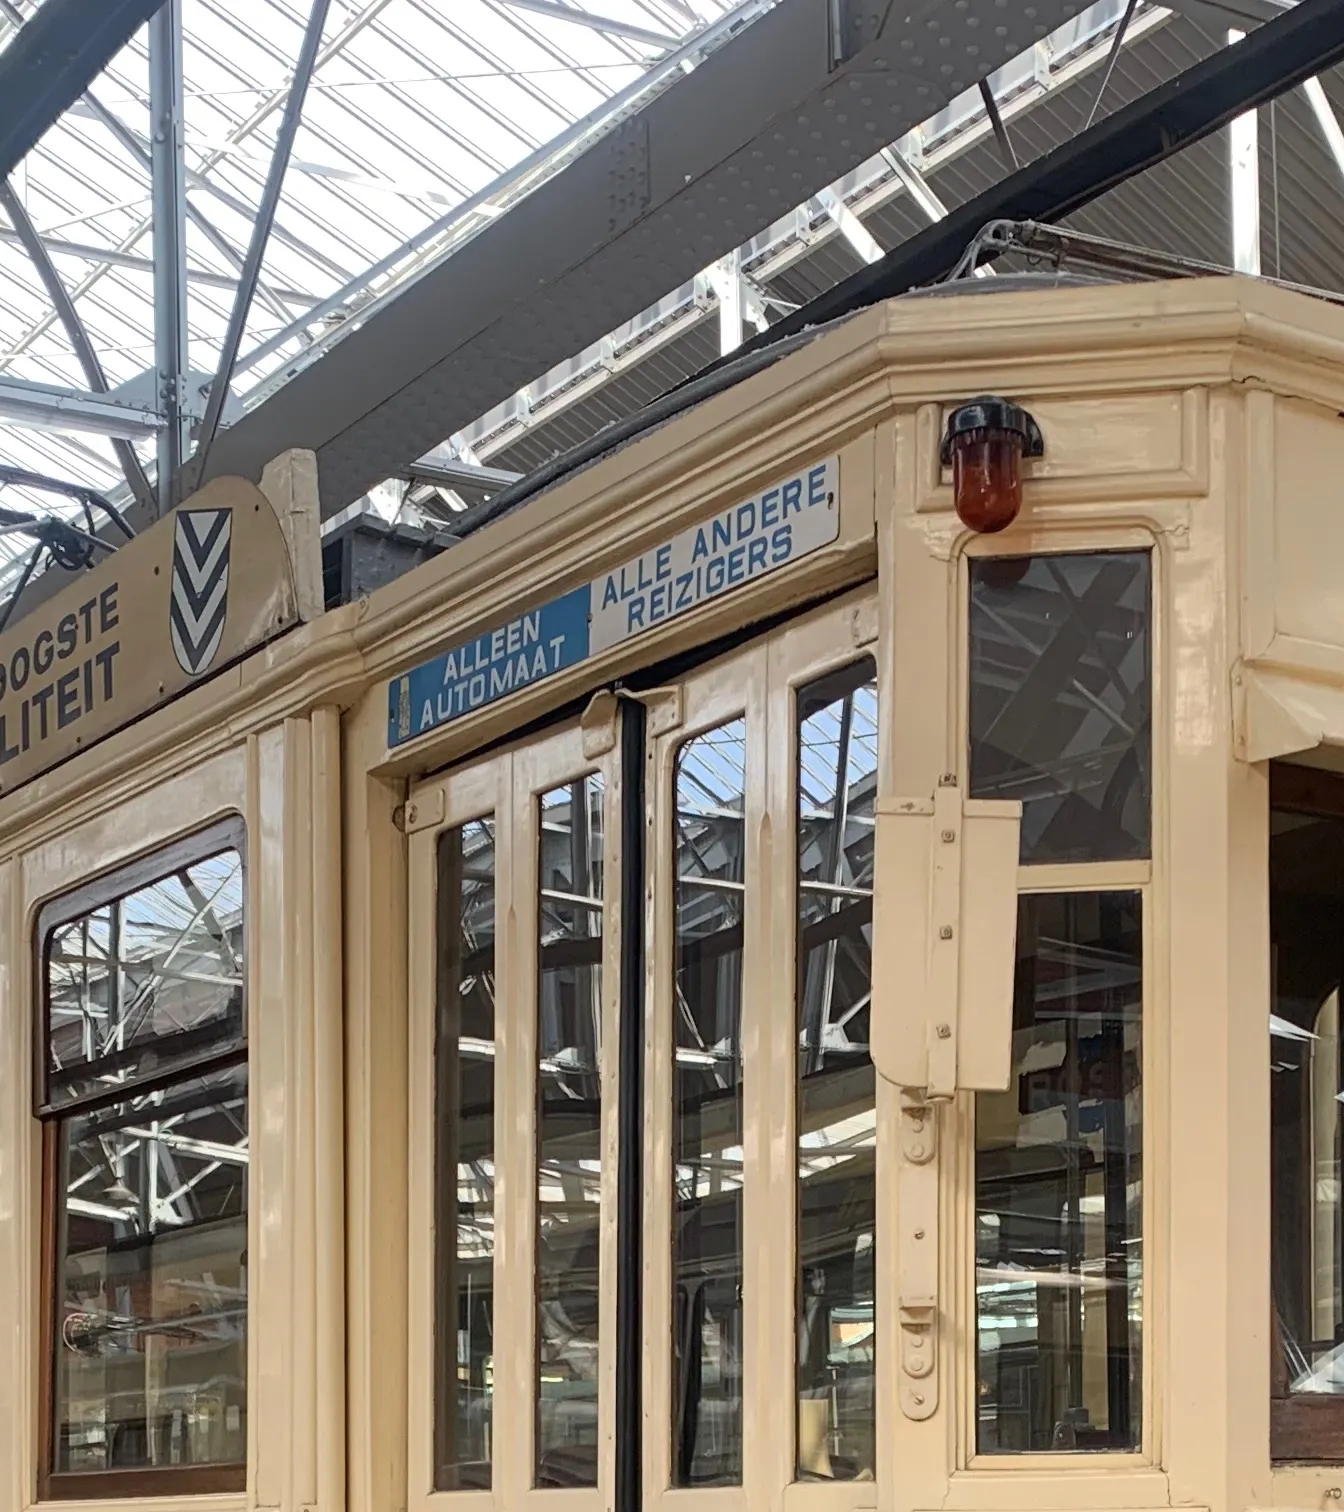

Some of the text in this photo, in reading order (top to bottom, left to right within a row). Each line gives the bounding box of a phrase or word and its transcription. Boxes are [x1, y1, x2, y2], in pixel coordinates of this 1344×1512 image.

[601, 464, 830, 611] ALLE ANDERE
[627, 525, 794, 634] REIZIGERS
[419, 635, 567, 731] AUTOMAAT
[442, 610, 541, 685] ALLEEN
